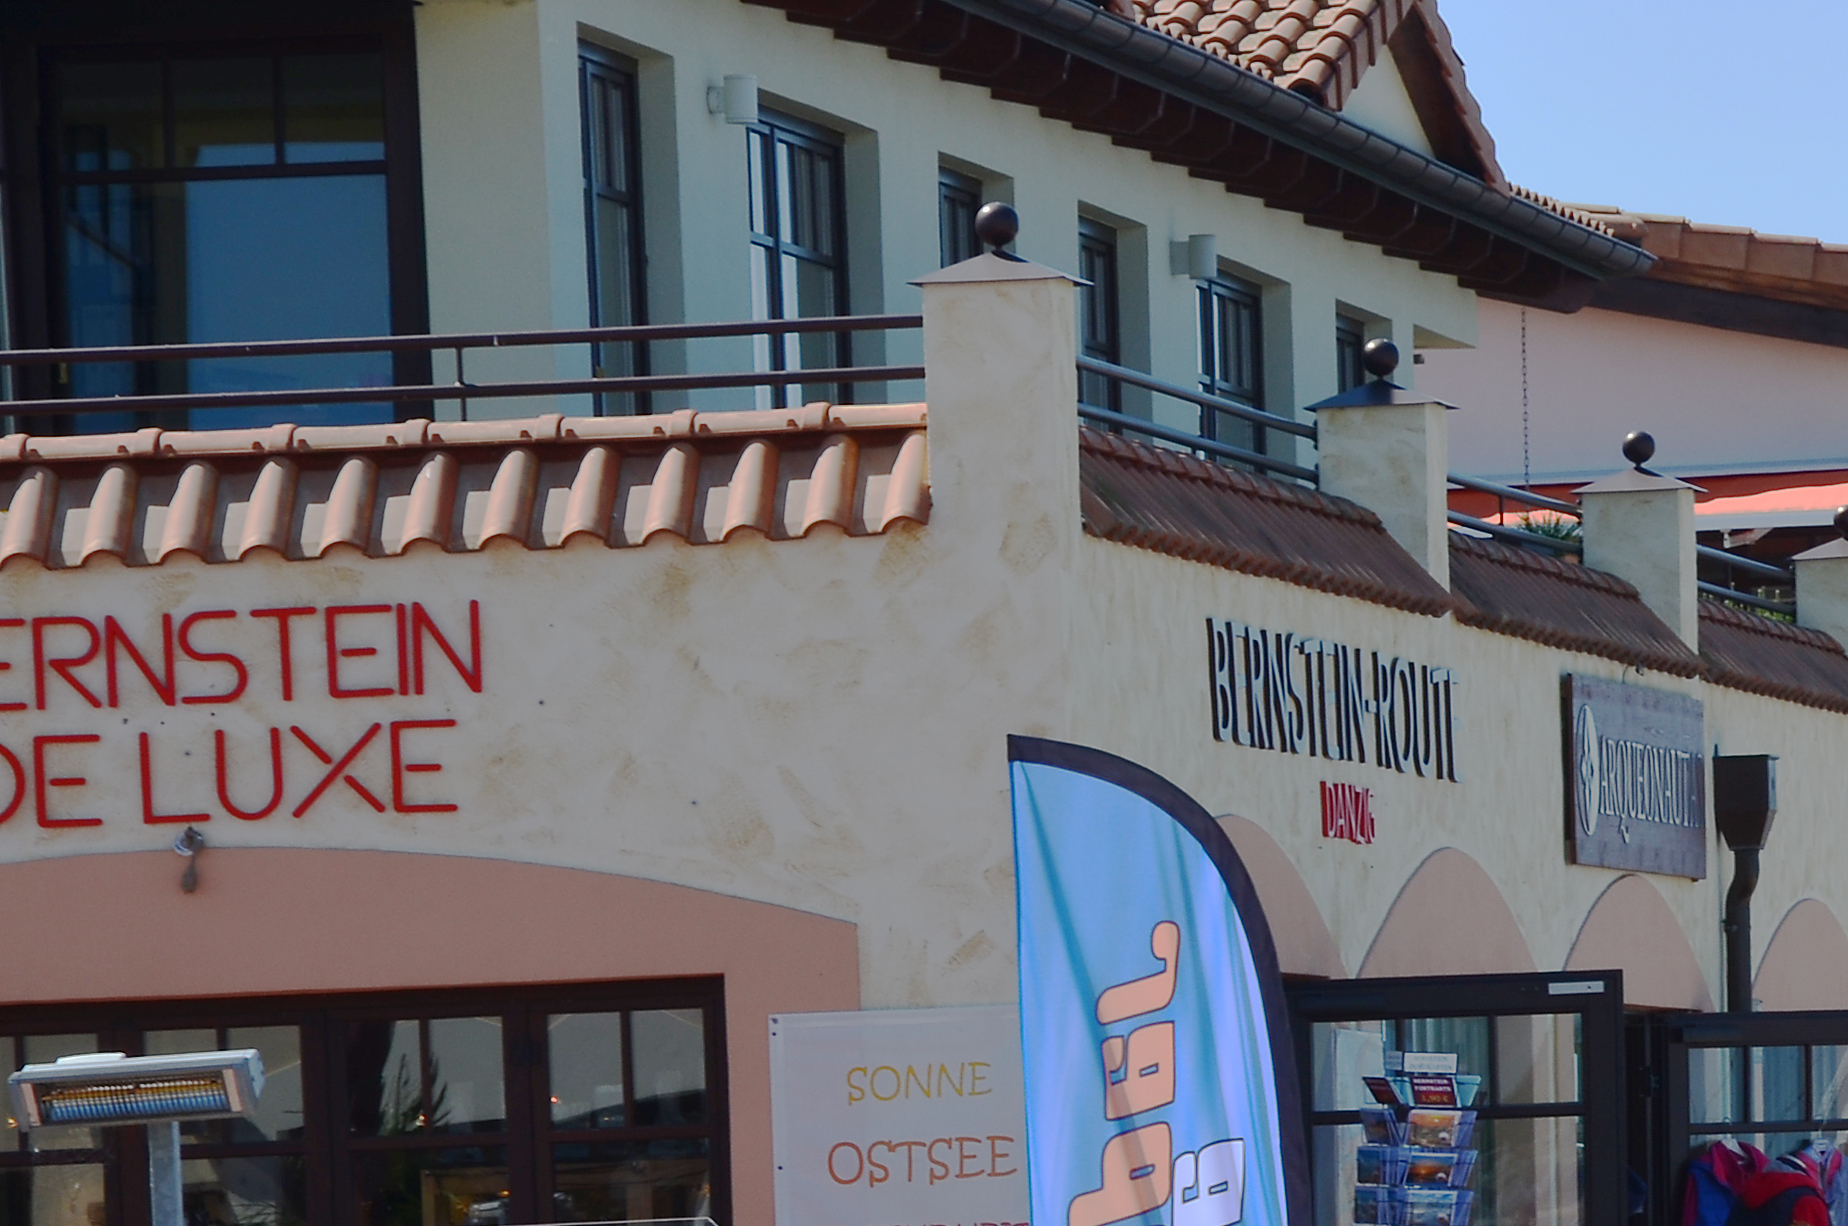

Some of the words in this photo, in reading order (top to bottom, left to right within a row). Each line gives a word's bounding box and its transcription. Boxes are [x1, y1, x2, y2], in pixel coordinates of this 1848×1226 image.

[0, 600, 482, 710] ERNSTEIN
[1206, 617, 1463, 783] BERNSTEIN-ROUTE
[139, 719, 458, 824] LUXE
[1320, 781, 1376, 844] DANZIG
[847, 1062, 992, 1105] SONNE
[828, 1135, 1017, 1187] OSTSEE
